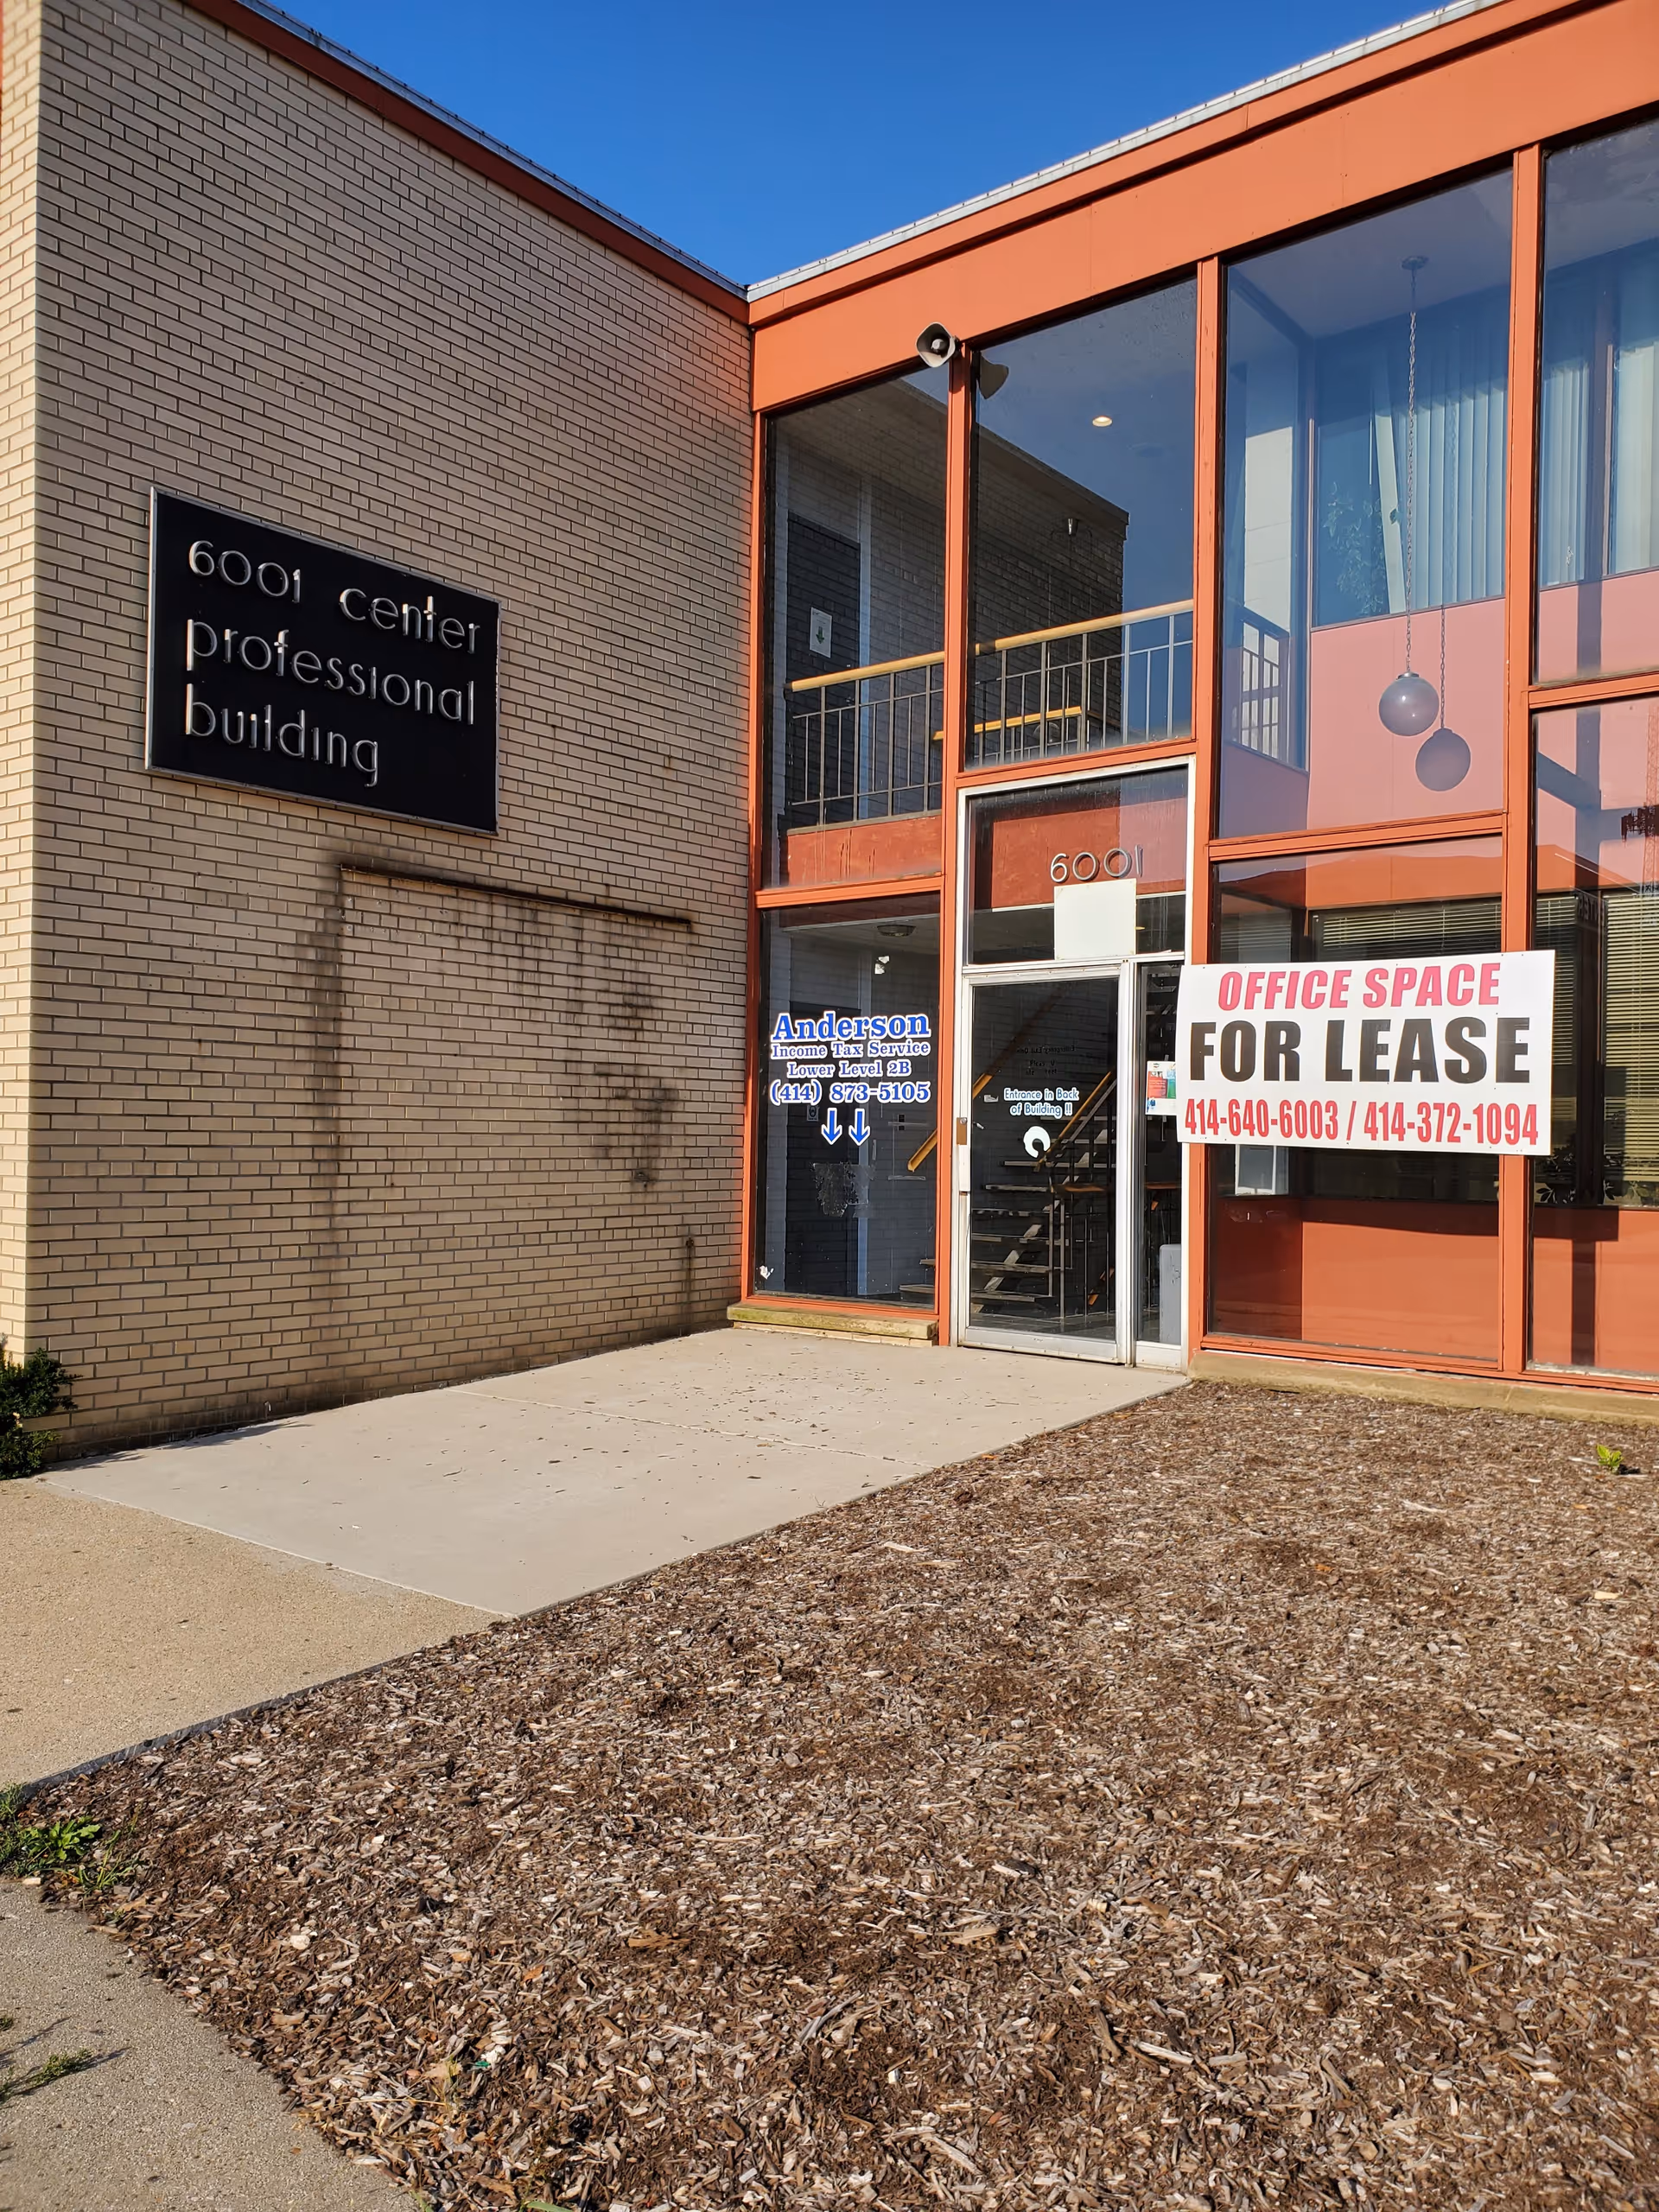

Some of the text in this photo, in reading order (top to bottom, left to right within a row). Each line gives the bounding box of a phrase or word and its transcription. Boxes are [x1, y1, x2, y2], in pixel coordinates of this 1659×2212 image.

[188, 539, 480, 654] 6001 center
[186, 619, 474, 725] professional
[185, 683, 378, 787] building
[1050, 844, 1143, 883] 6001
[1218, 963, 1501, 1011] OFFICE SPACE
[772, 1012, 930, 1041] Anderson
[772, 1039, 930, 1058] Income Tax Service
[1190, 1016, 1530, 1084] FOR LEASE
[788, 1060, 911, 1077] Lower Level 2B
[771, 1080, 930, 1103] (414) 873-5105
[1005, 1088, 1078, 1100] Entrance in Back
[1011, 1103, 1021, 1114] of
[1025, 1103, 1061, 1118] Building
[1185, 1098, 1338, 1141] 414-640-6003
[1364, 1102, 1538, 1146] 414-372-1094
